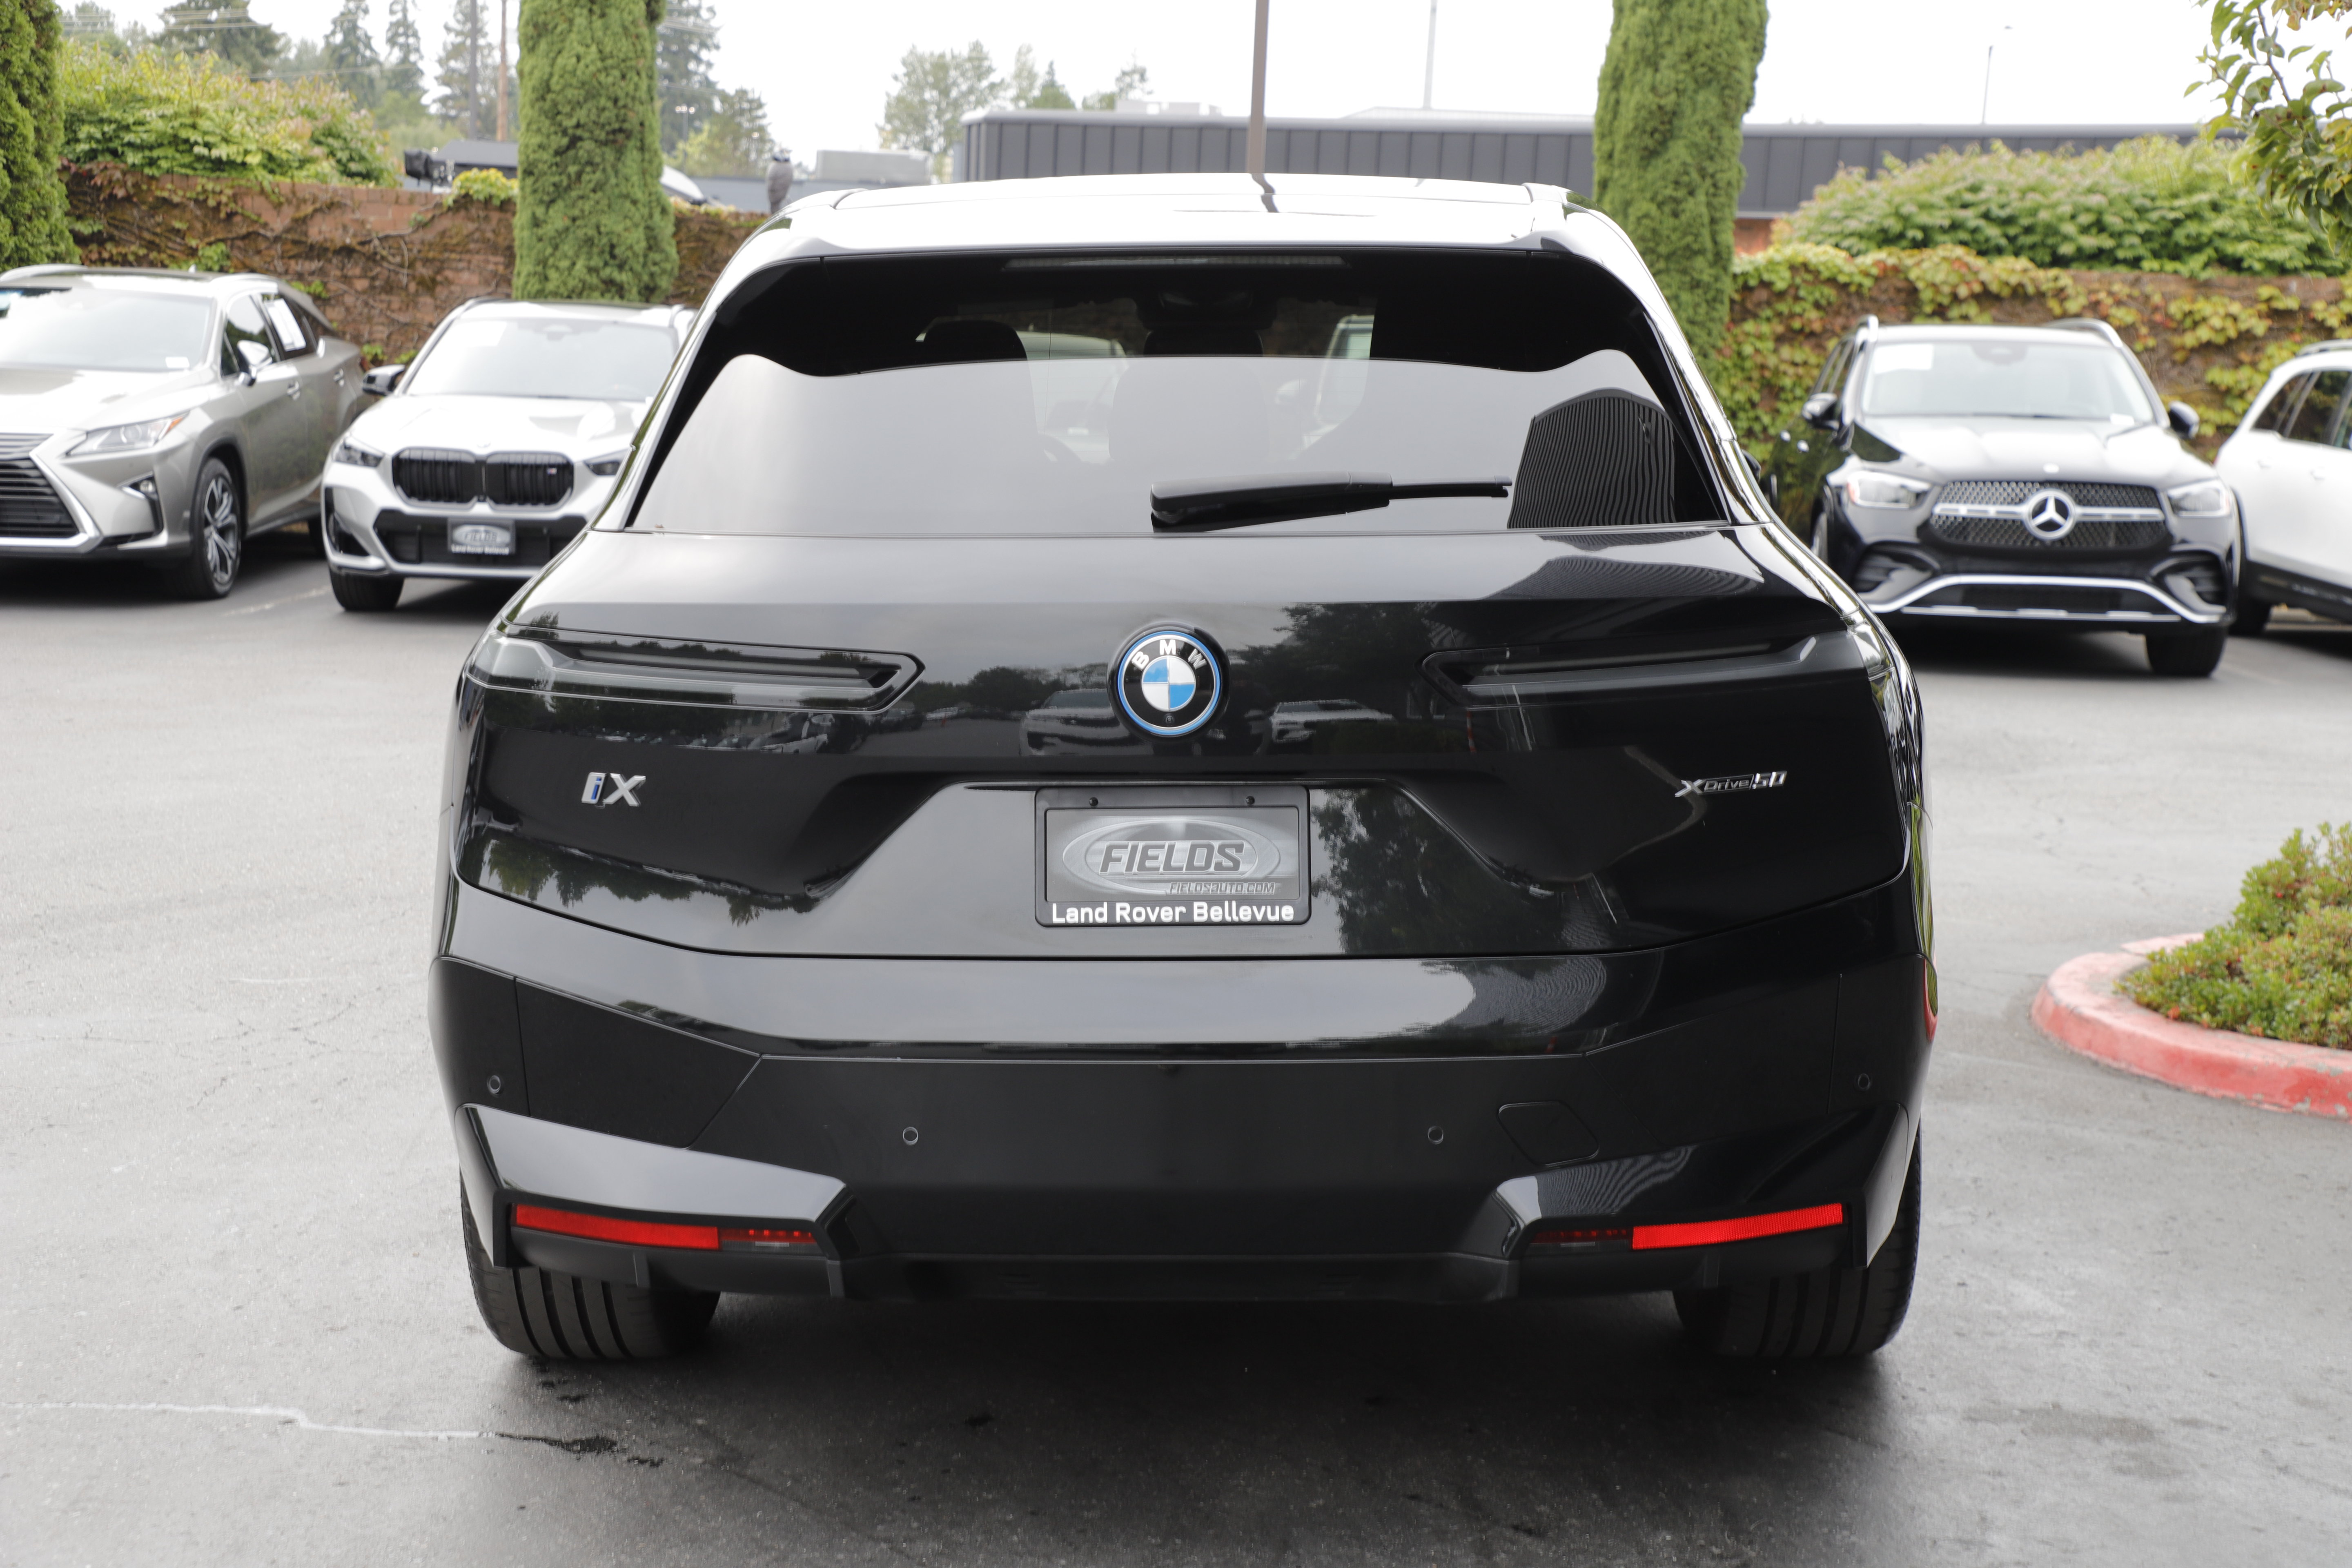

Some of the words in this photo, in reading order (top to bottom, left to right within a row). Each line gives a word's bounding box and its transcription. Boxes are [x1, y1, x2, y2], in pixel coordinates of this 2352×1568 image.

[1131, 639, 1207, 671] BMW
[581, 772, 646, 807] iX
[1099, 840, 1245, 875] FIELDS
[1052, 902, 1108, 924] Land
[1115, 902, 1186, 923] Rover
[1193, 900, 1295, 922] Bellevue
